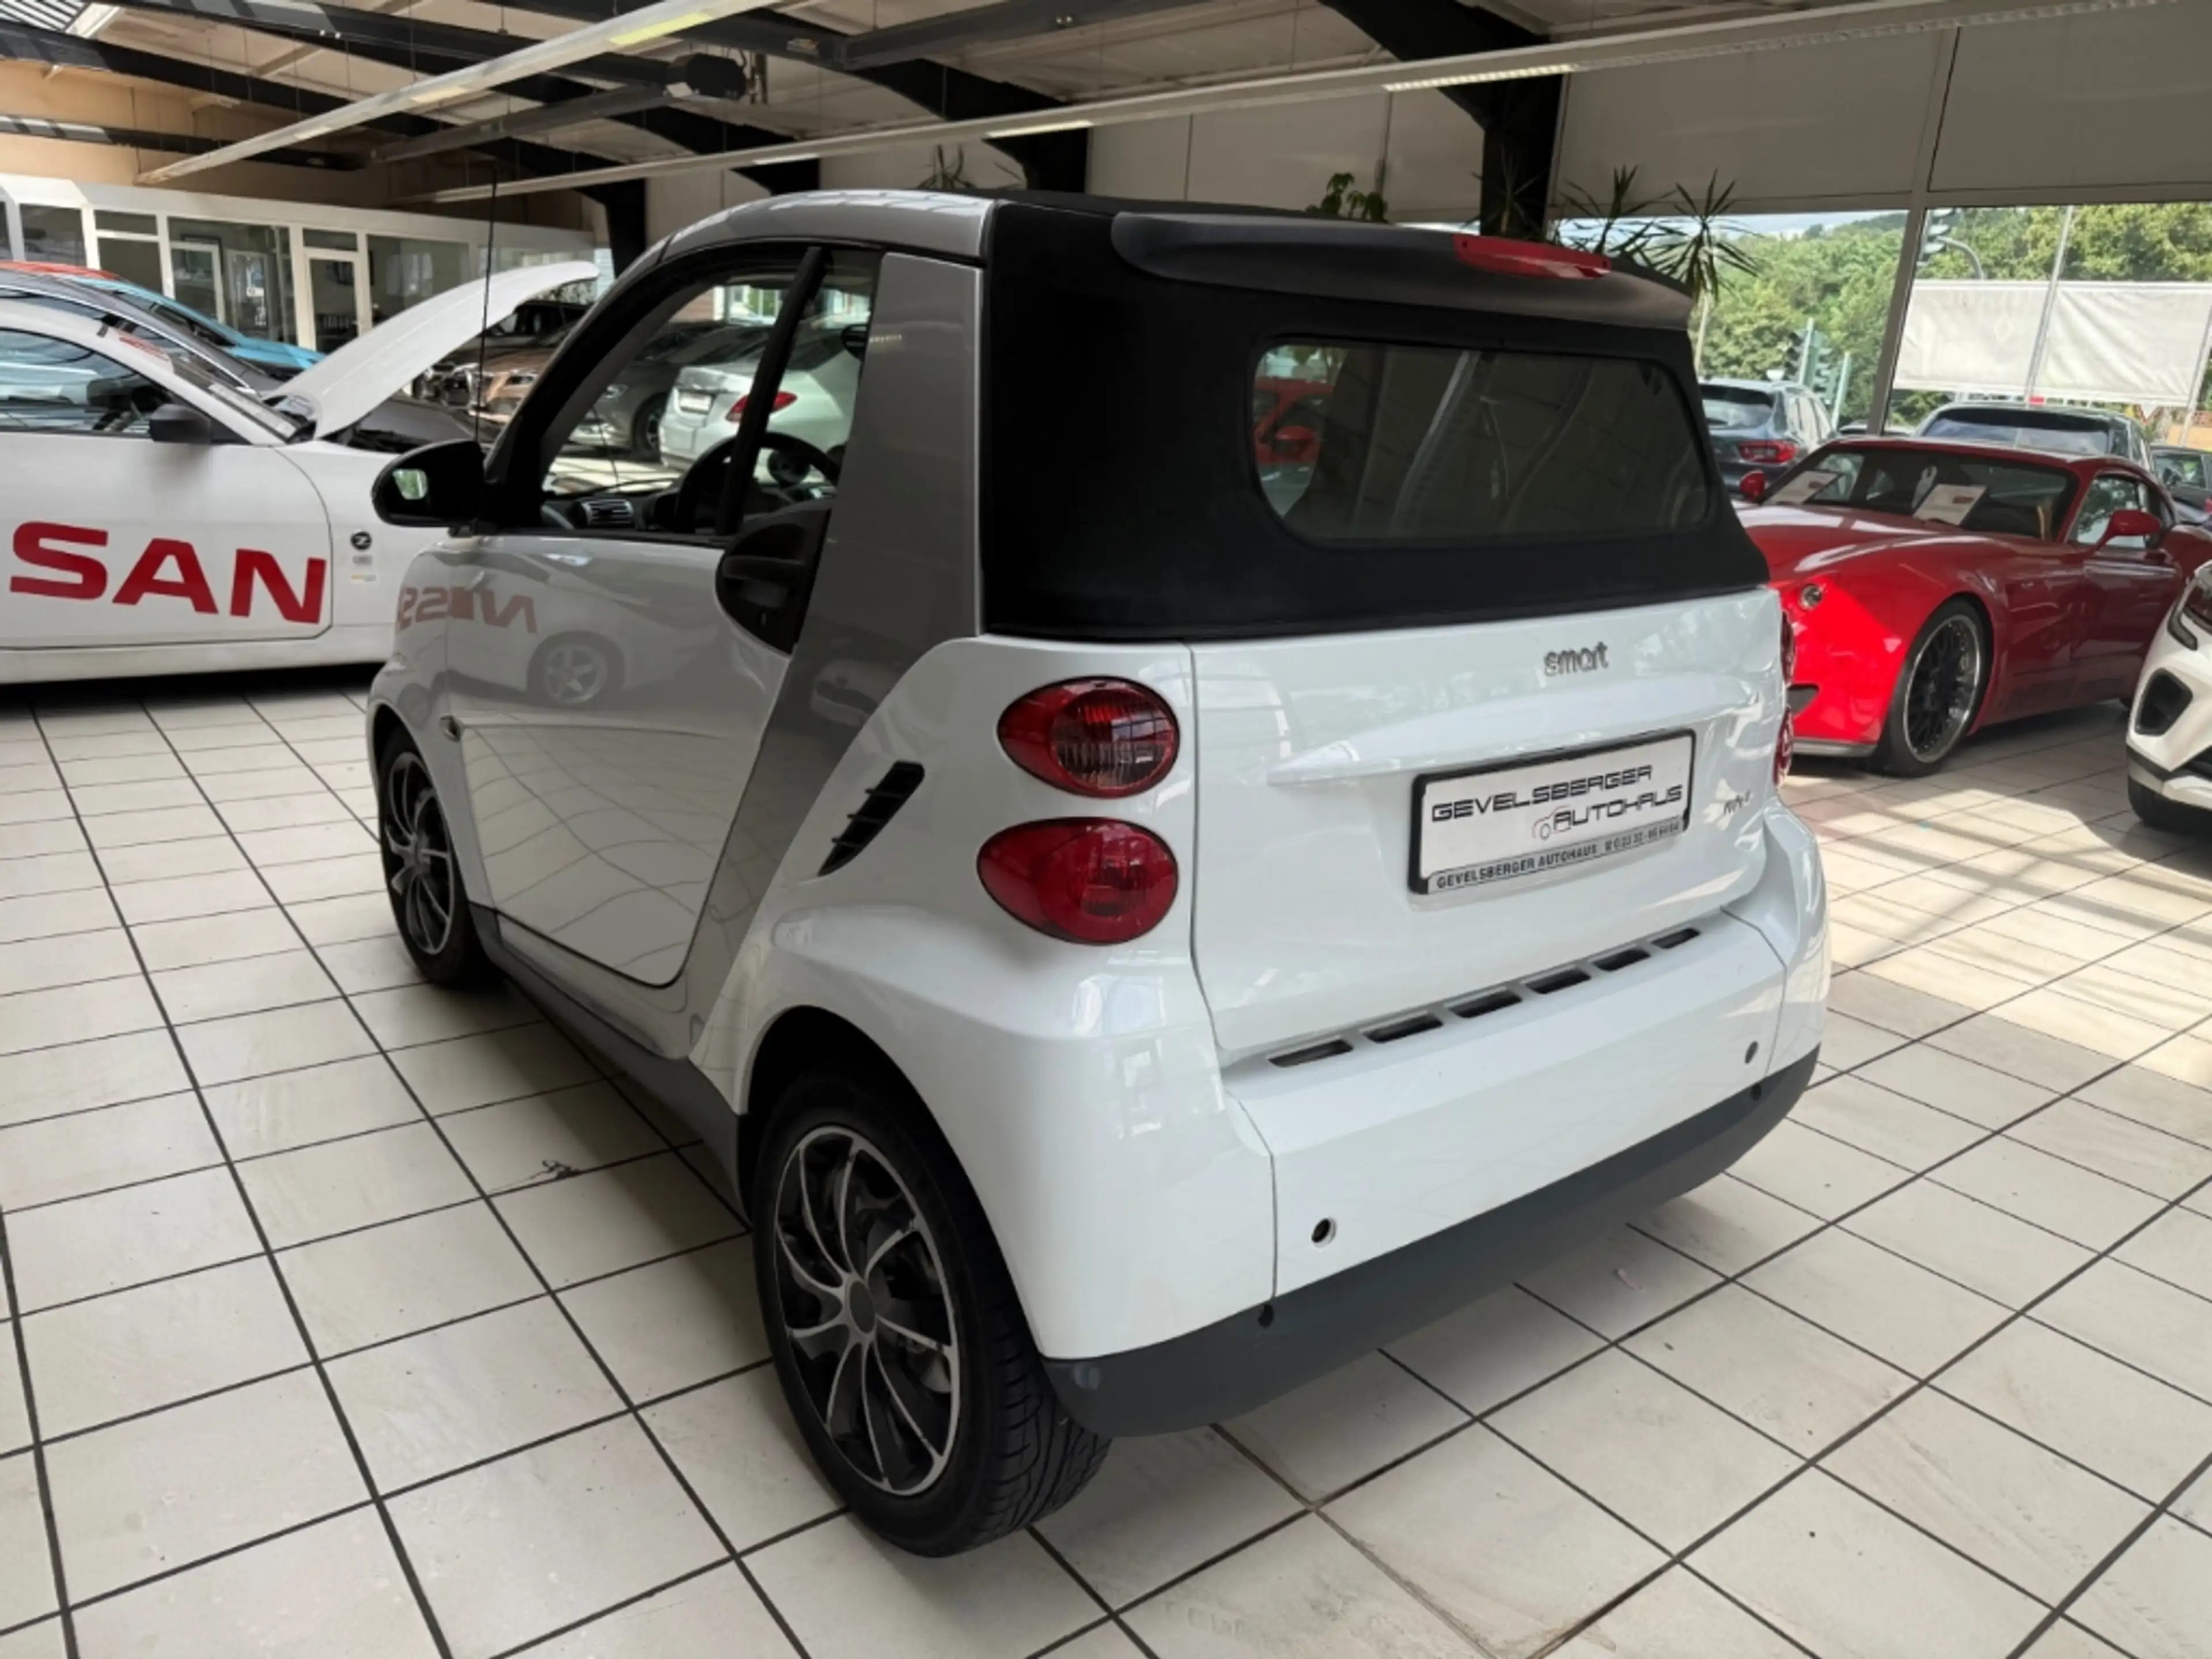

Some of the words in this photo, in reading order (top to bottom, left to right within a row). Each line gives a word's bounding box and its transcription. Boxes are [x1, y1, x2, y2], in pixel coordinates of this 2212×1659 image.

[10, 521, 326, 624] SAN
[1544, 641, 1609, 676] smart
[1432, 764, 1653, 822] GEVELSBERGER
[1553, 785, 1683, 831] AUTOHAUS
[1436, 857, 1535, 889] GEVELSBERGER
[1537, 843, 1597, 868] AUTOHAUS
